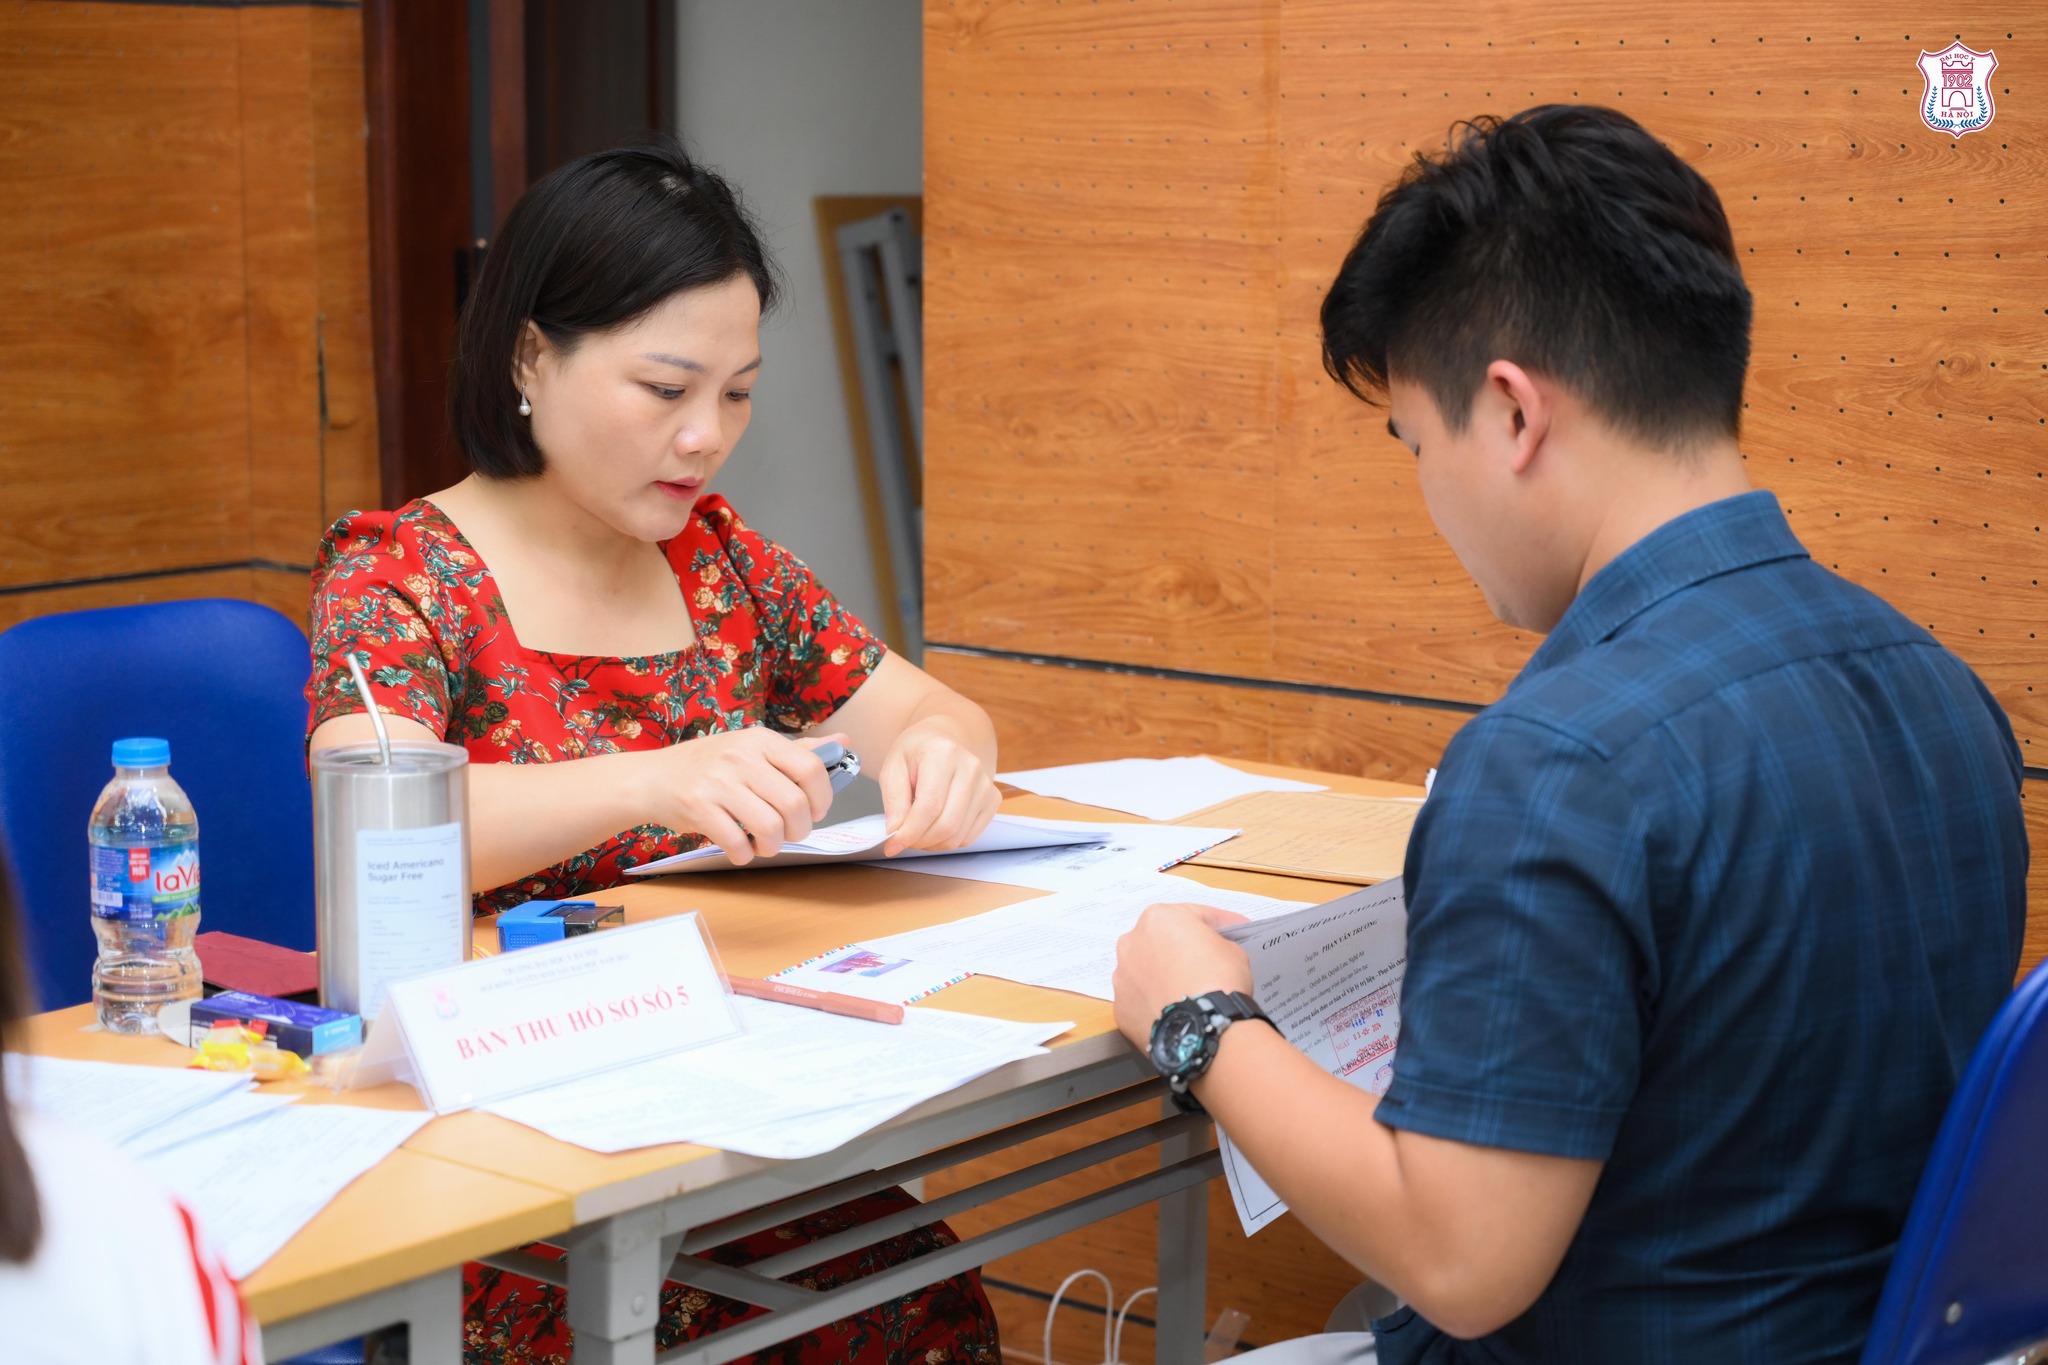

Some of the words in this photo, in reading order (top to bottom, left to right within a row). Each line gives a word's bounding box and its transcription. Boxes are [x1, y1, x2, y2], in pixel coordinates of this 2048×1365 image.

[367, 861, 390, 870] Iced
[393, 858, 446, 870] Americano
[367, 872, 398, 884] Sugar
[401, 872, 424, 881] Free
[512, 1017, 563, 1045] THU
[567, 1000, 604, 1033] HỒ
[608, 996, 639, 1022] SƠ
[641, 983, 673, 1013] SỐ
[676, 985, 690, 1006] 5
